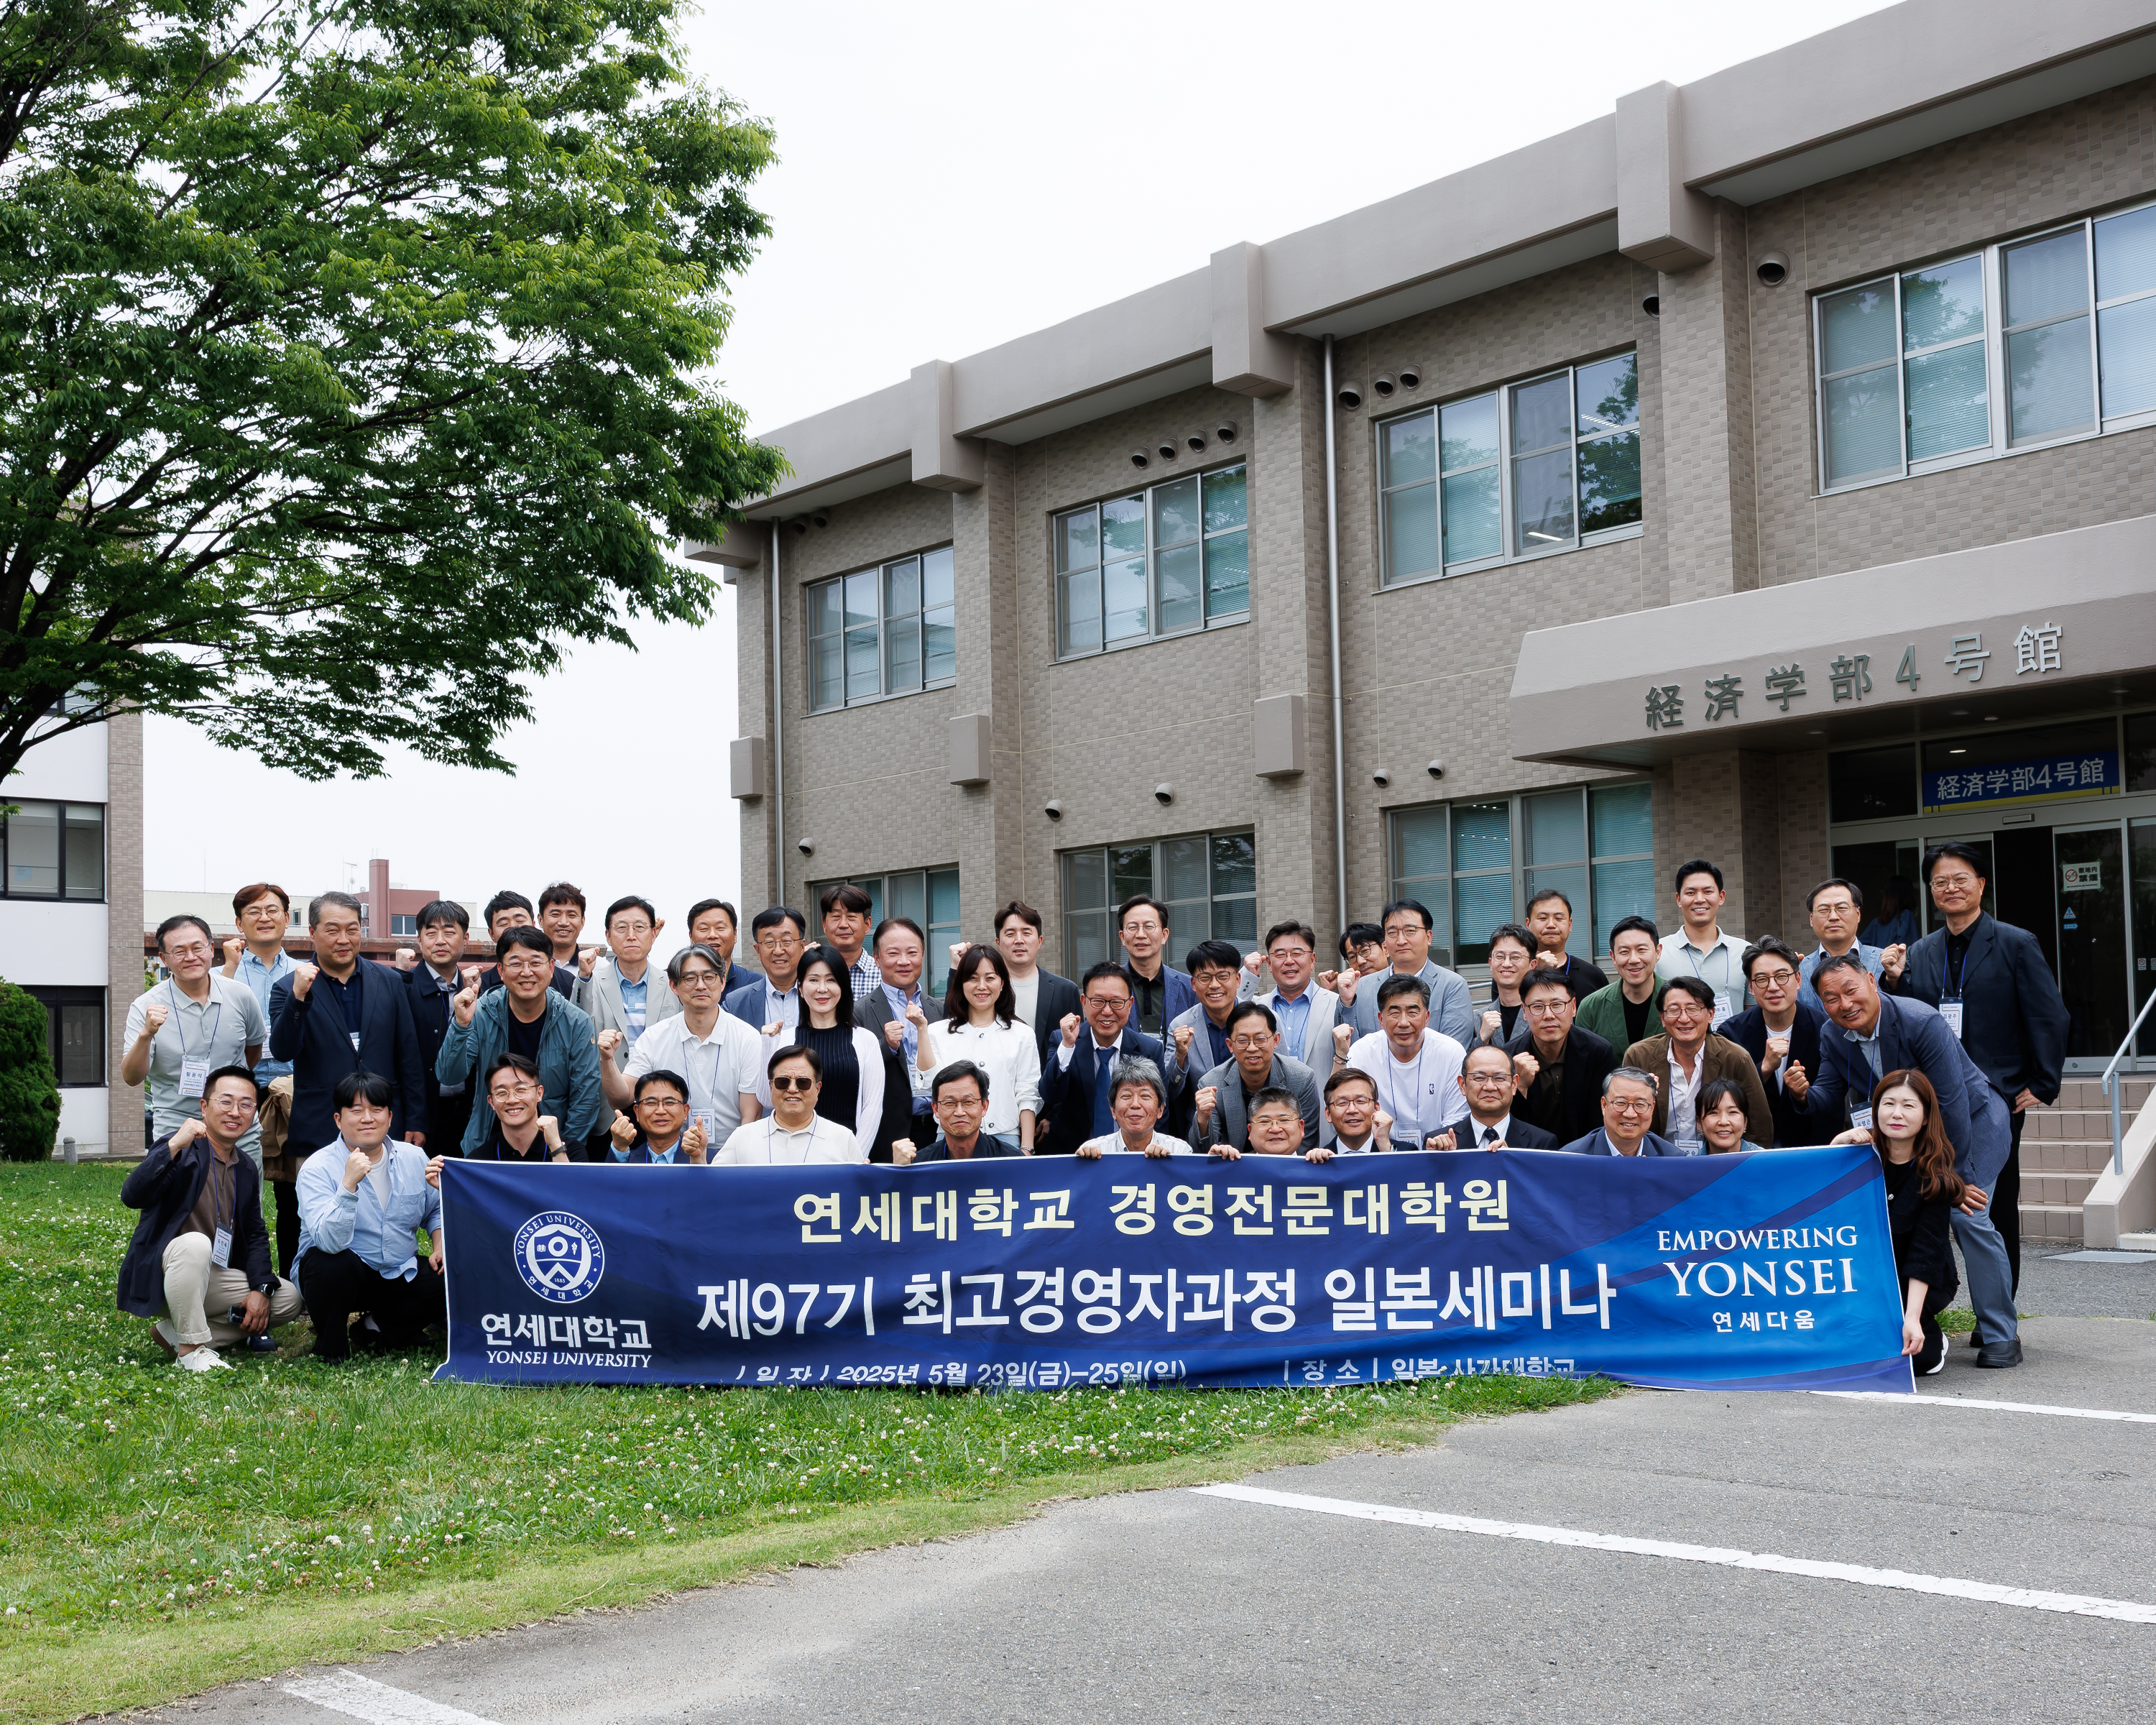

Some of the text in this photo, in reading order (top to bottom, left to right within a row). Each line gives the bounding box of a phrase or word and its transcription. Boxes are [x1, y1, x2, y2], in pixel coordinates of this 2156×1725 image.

[1644, 622, 2063, 730] 経済学部4号館
[1937, 758, 2104, 800] 経済学部4号館
[793, 1179, 1509, 1243] 연세대학교 경영전문대학원
[517, 1215, 601, 1259] YONSEI UNIVERSITY
[1657, 1225, 1858, 1251] EMPOWERING
[1662, 1258, 1858, 1297] YONSEI
[696, 1262, 1617, 1339] 제97기 최고경영자과정 일본세미나
[481, 1313, 652, 1349] 연세대학교
[1712, 1310, 1815, 1333] 연세다움
[486, 1351, 652, 1368] YONSEI UNIVERSITY
[837, 1363, 920, 1384] 2025년
[928, 1362, 967, 1386] 5월
